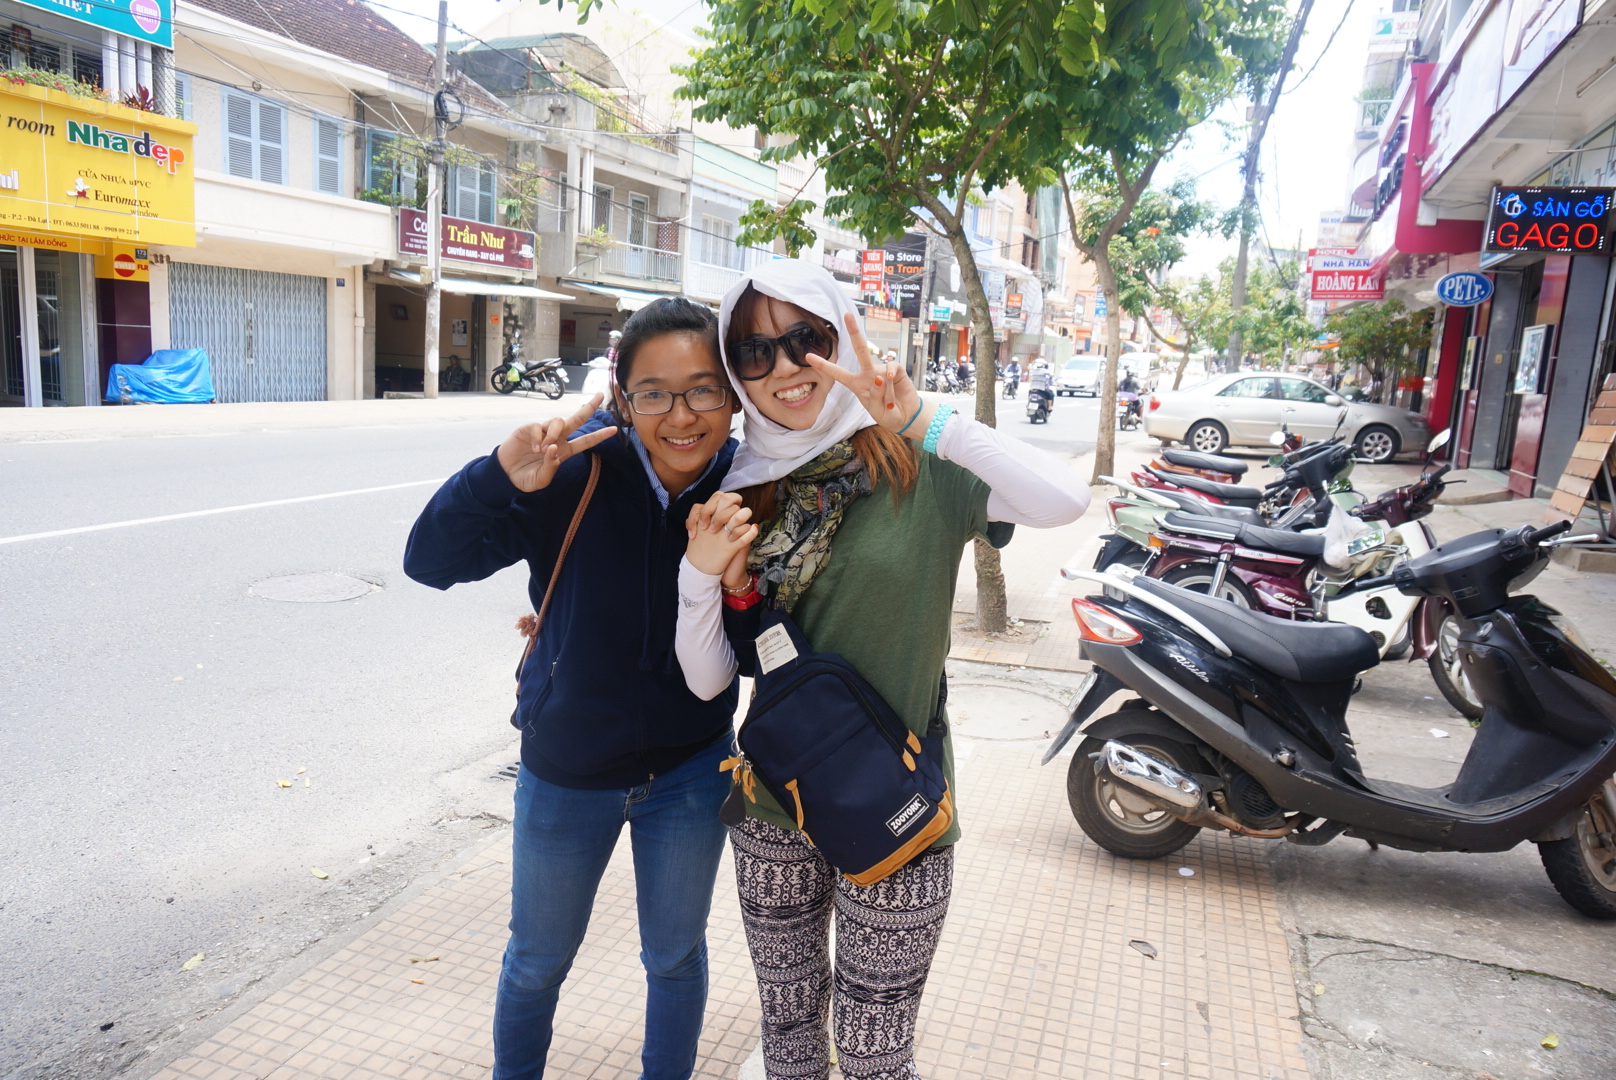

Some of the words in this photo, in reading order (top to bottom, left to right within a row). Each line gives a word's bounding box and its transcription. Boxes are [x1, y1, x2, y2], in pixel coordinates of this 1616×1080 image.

[7, 116, 55, 136] room
[129, 179, 151, 188] uPVC
[94, 189, 151, 208] Euromaxx
[1574, 195, 1605, 217] GỖ
[130, 209, 159, 218] window
[448, 225, 477, 245] Trần
[480, 231, 505, 249] Như
[1497, 222, 1598, 248] GAGO
[896, 252, 922, 262] Store
[1168, 652, 1210, 683] Attila
